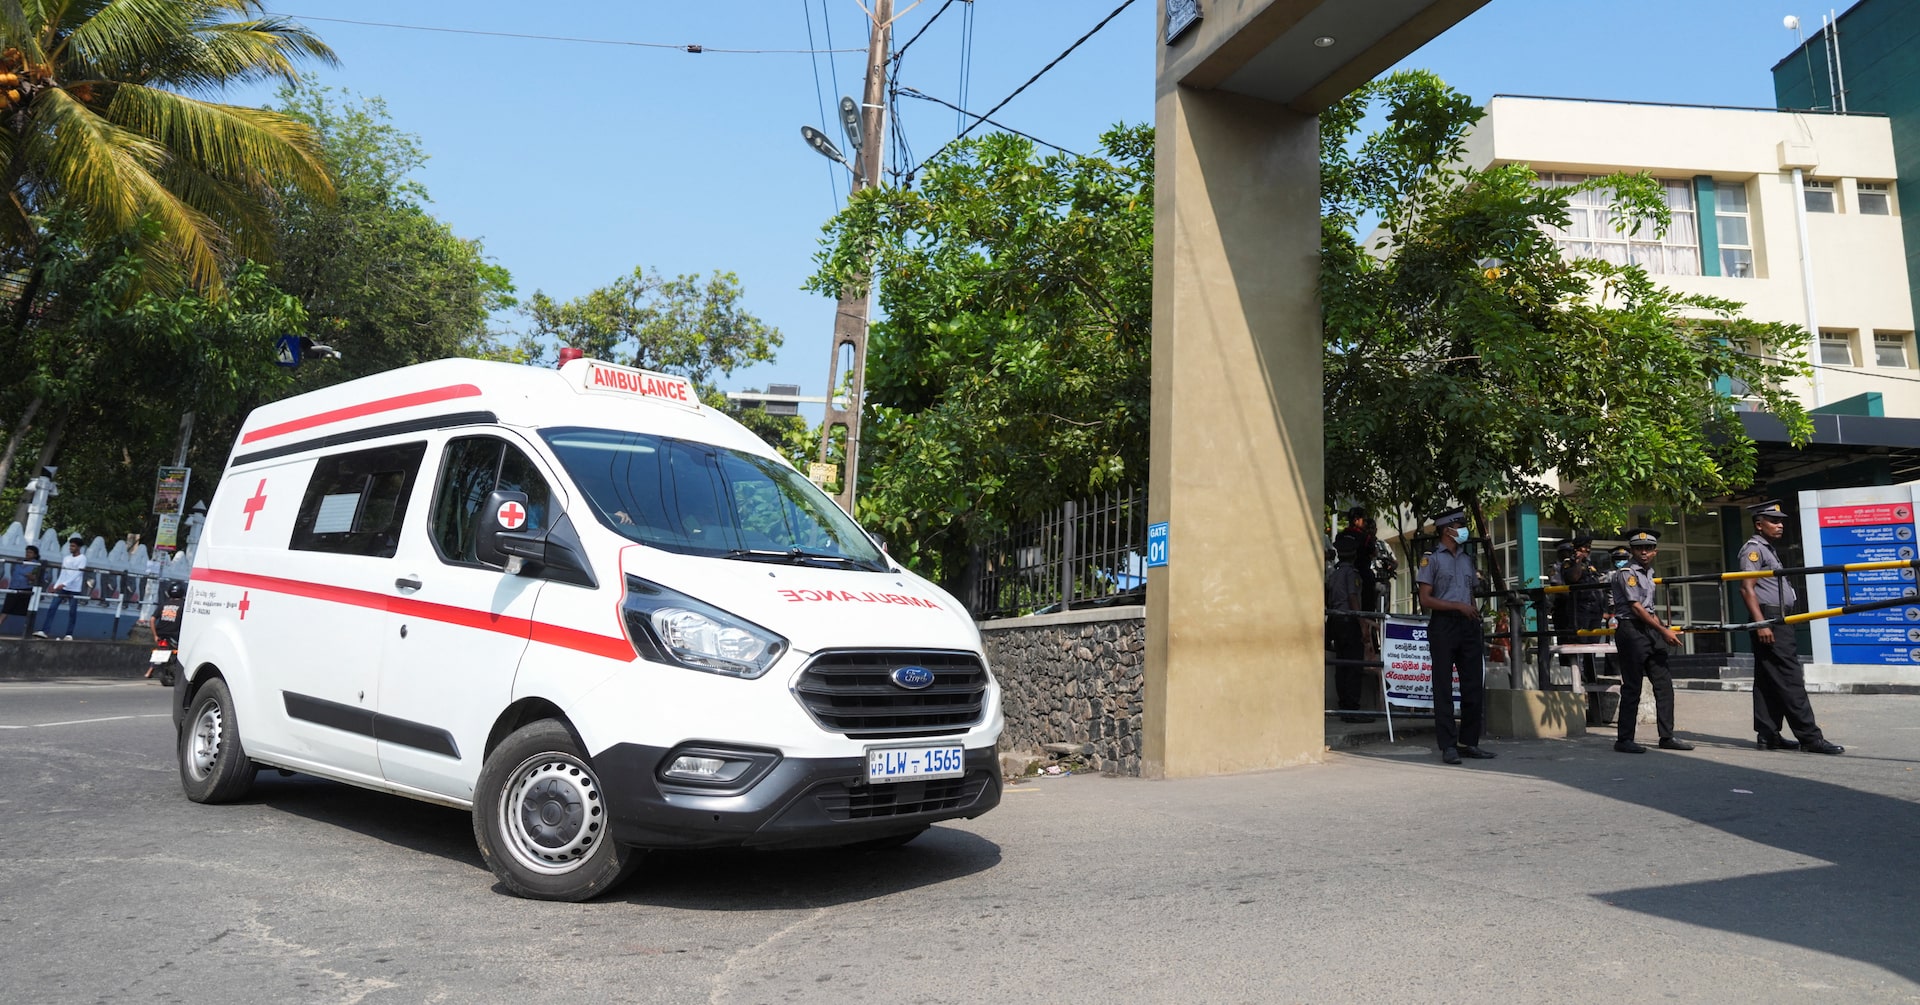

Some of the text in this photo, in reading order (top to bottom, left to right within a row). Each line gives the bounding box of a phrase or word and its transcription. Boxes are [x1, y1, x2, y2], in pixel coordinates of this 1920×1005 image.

[594, 367, 688, 402] AMBULANCE
[1150, 526, 1167, 538] GATE
[1150, 540, 1165, 562] 01
[904, 669, 928, 683] Ford
